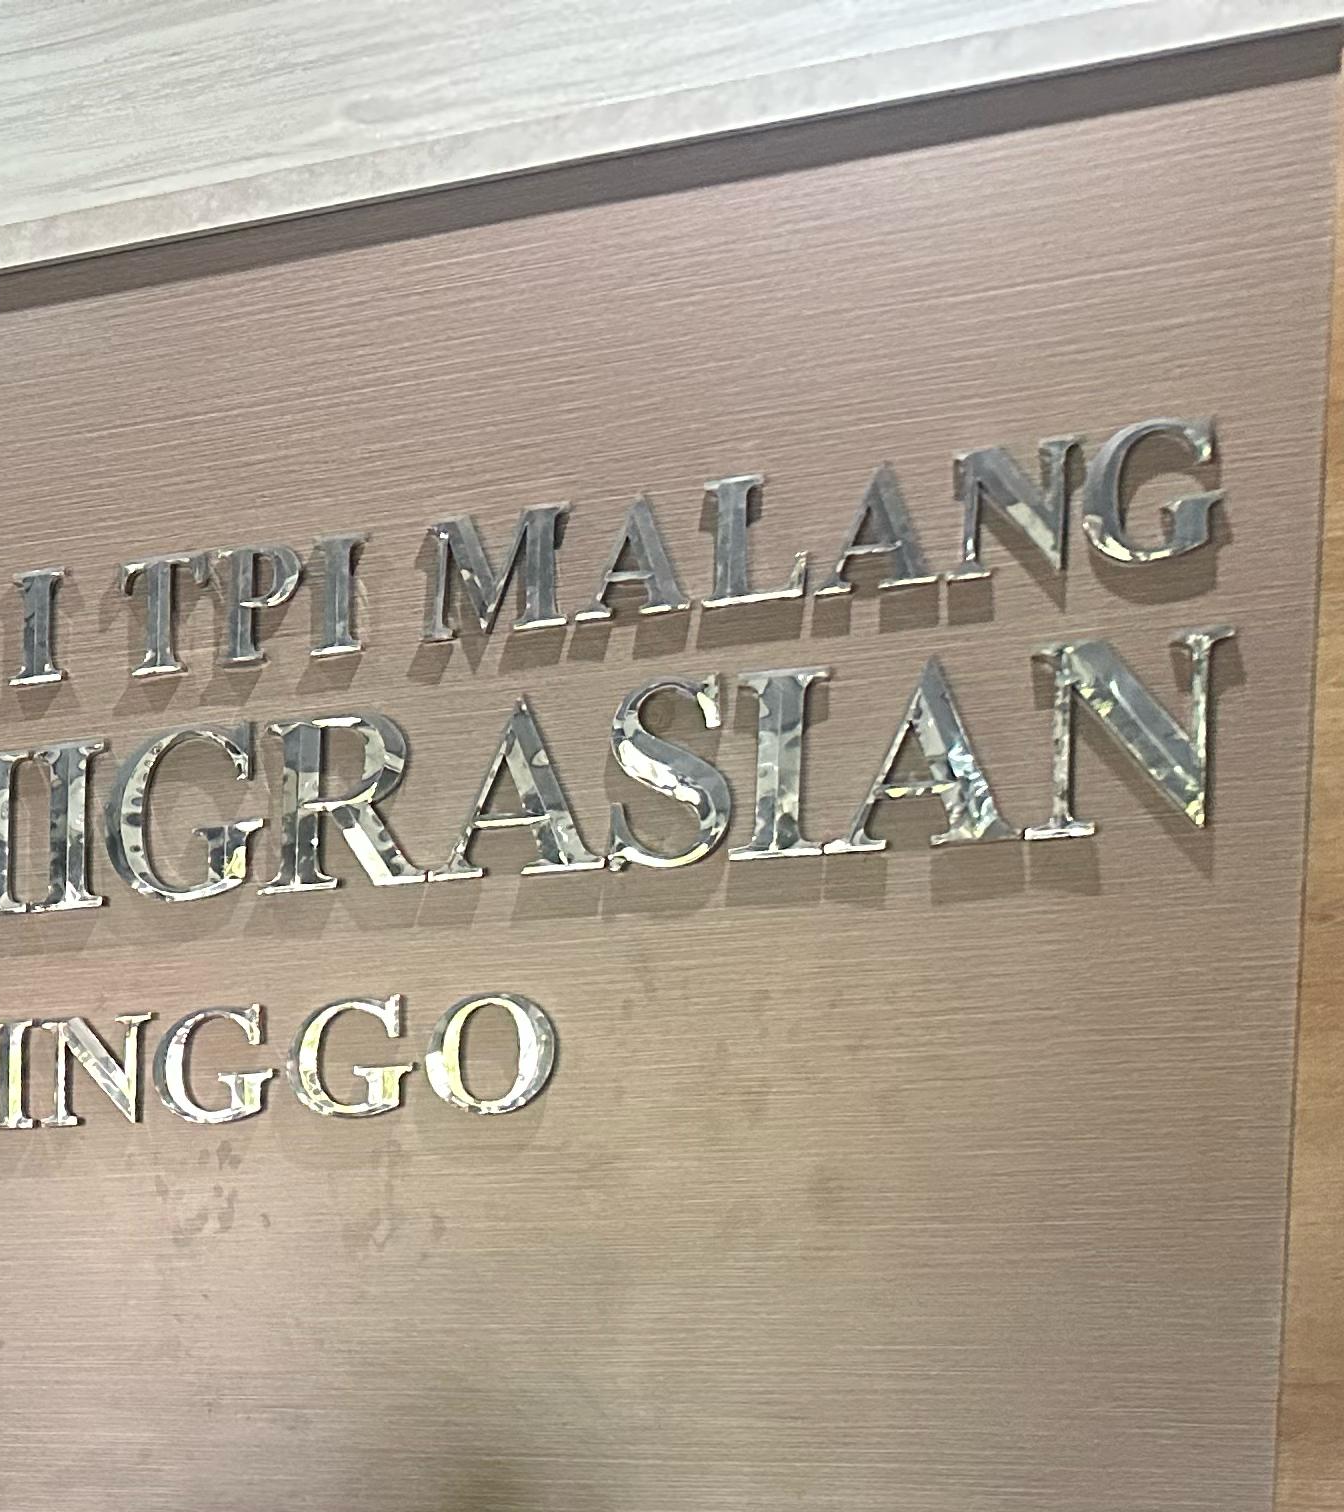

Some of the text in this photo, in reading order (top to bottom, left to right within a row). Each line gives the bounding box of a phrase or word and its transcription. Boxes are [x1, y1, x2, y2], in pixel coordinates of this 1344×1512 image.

[8, 567, 70, 687] I
[117, 532, 370, 679] TPI
[421, 416, 1224, 643] MALANG
